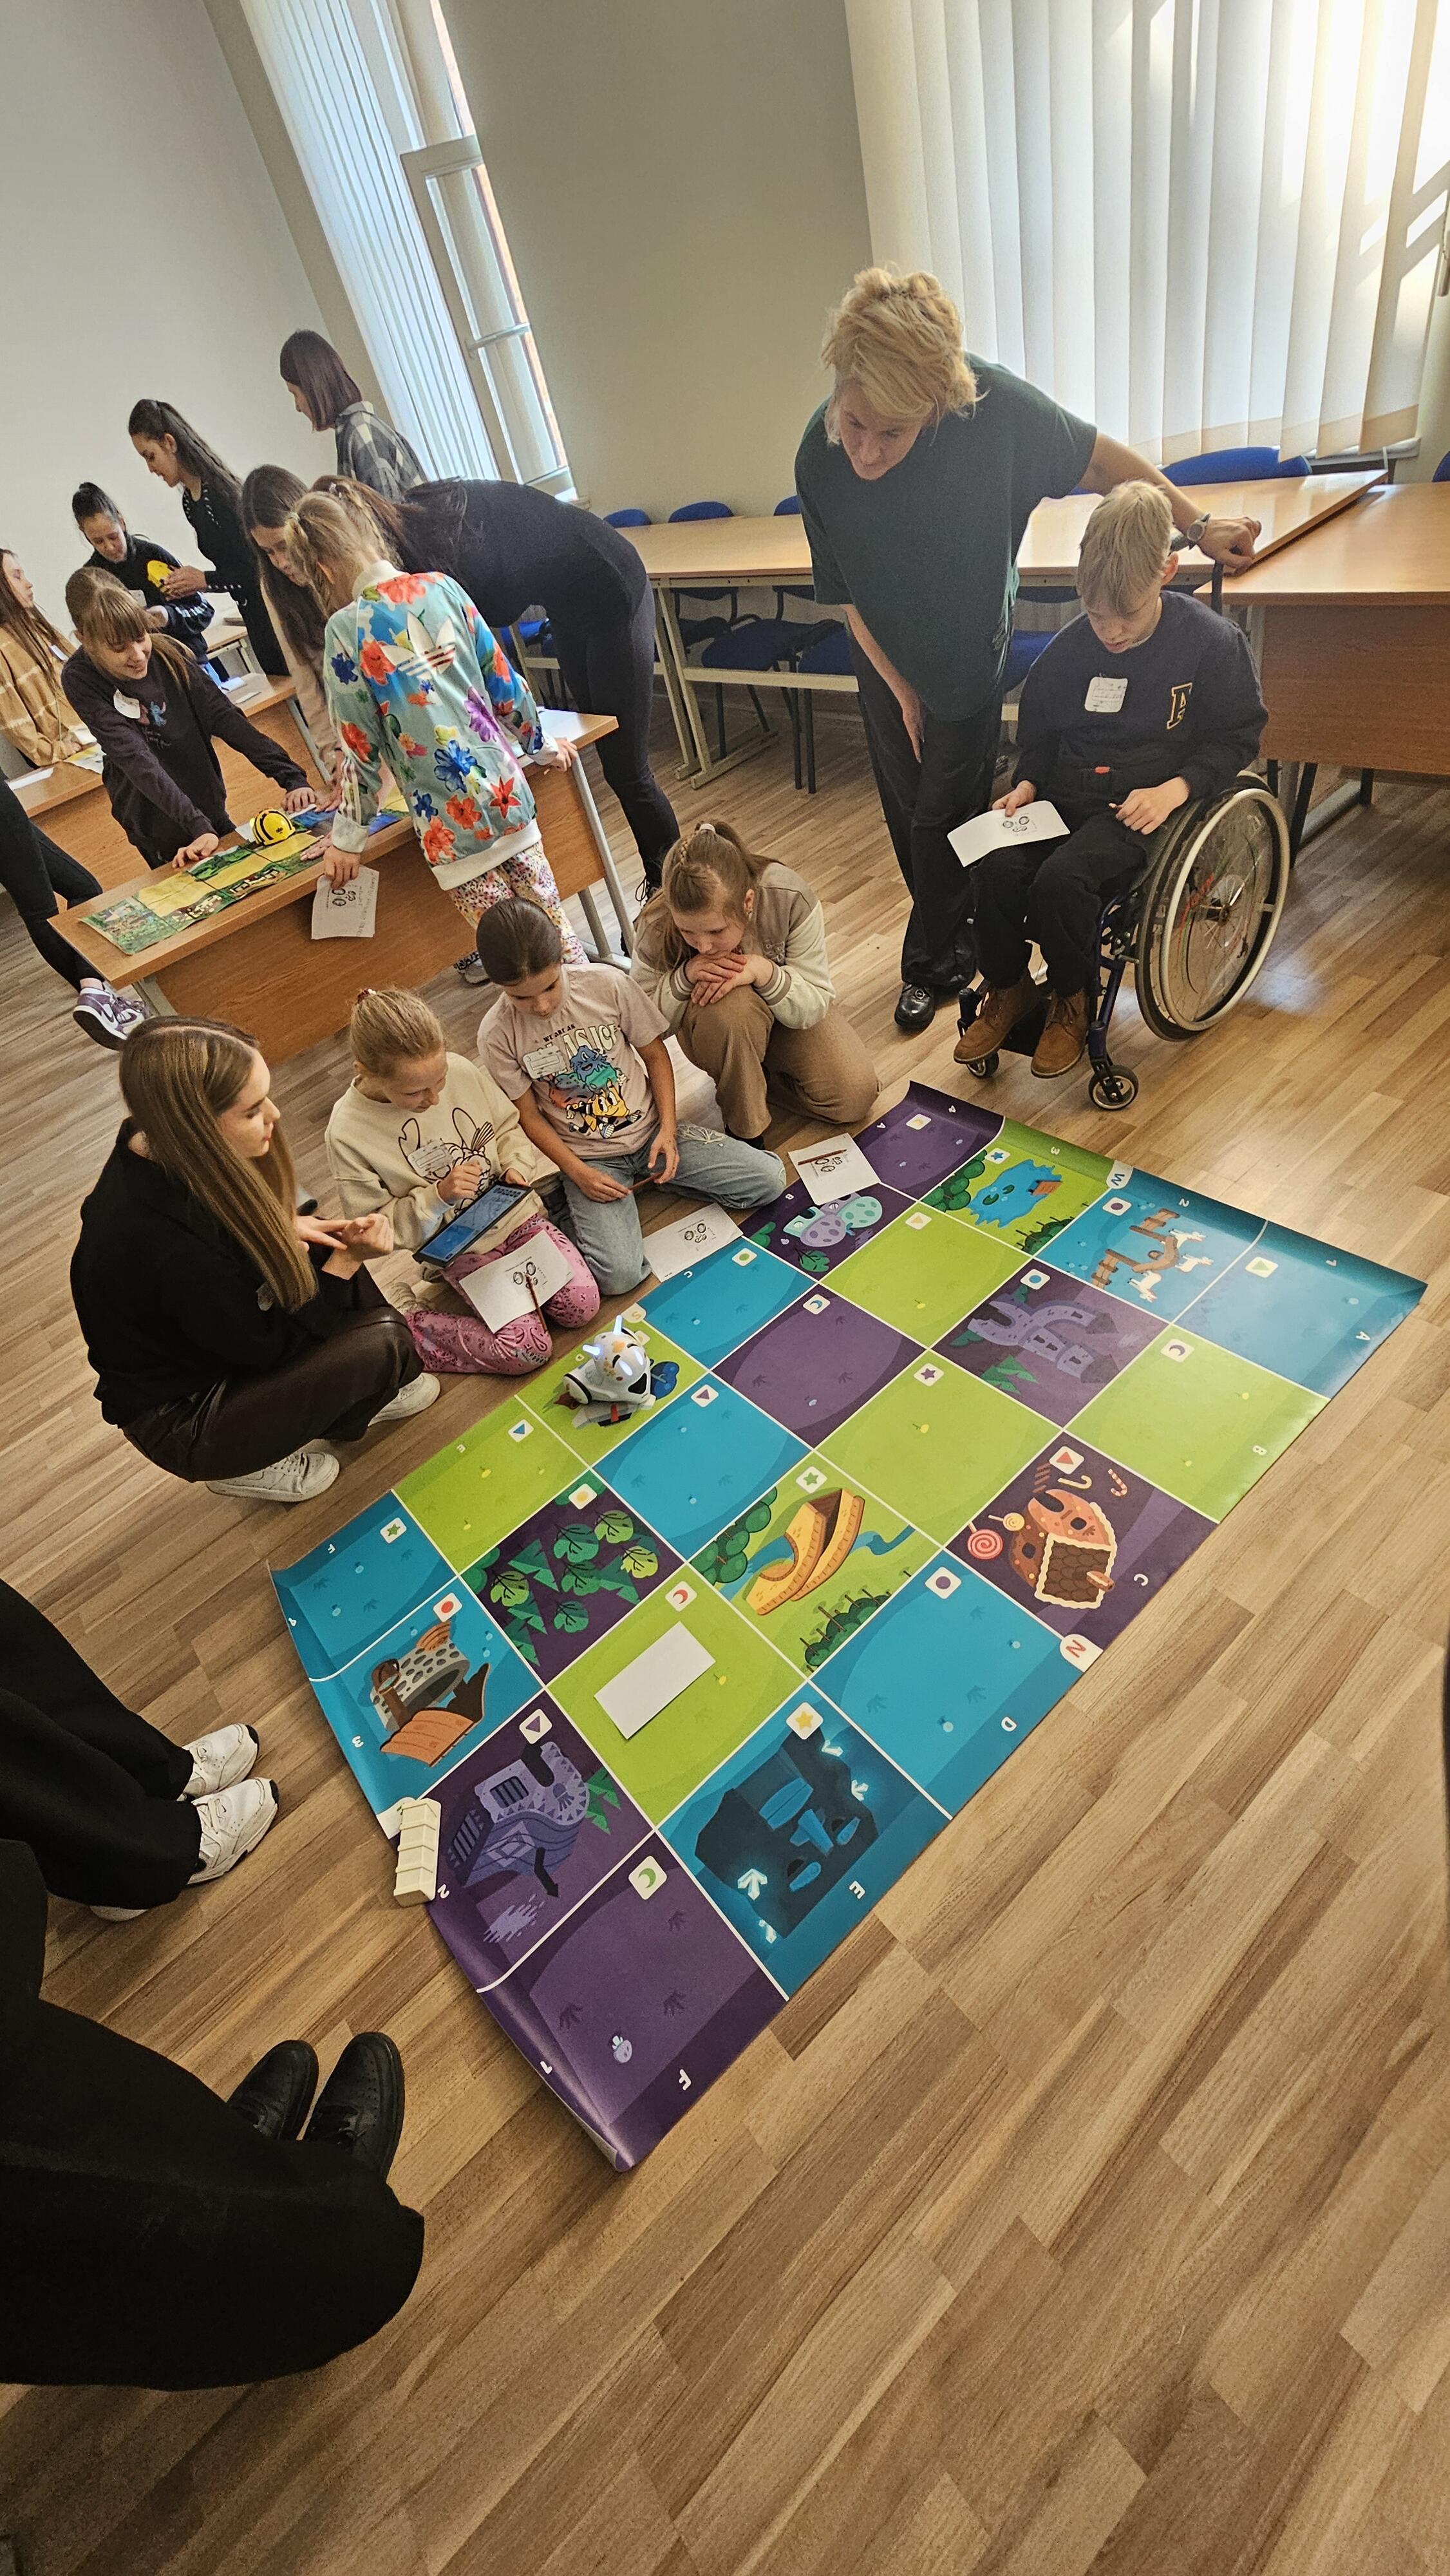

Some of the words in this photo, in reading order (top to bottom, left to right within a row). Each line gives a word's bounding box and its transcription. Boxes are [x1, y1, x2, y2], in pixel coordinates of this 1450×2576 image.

[1051, 1146, 1060, 1155] 3
[1111, 1173, 1125, 1186] W
[1179, 1198, 1189, 1207] 2
[1355, 1331, 1371, 1341] A
[457, 1444, 466, 1453] E
[1252, 1445, 1268, 1455] B
[328, 1544, 335, 1554] F
[1133, 1574, 1149, 1586] C
[288, 1617, 297, 1626] 4
[1066, 1640, 1086, 1658] N
[1001, 1716, 1017, 1732] D
[352, 1736, 364, 1748] 3
[437, 1884, 449, 1899] 2
[849, 1880, 866, 1899] E
[540, 2061, 553, 2074] 1
[679, 2069, 692, 2090] F
